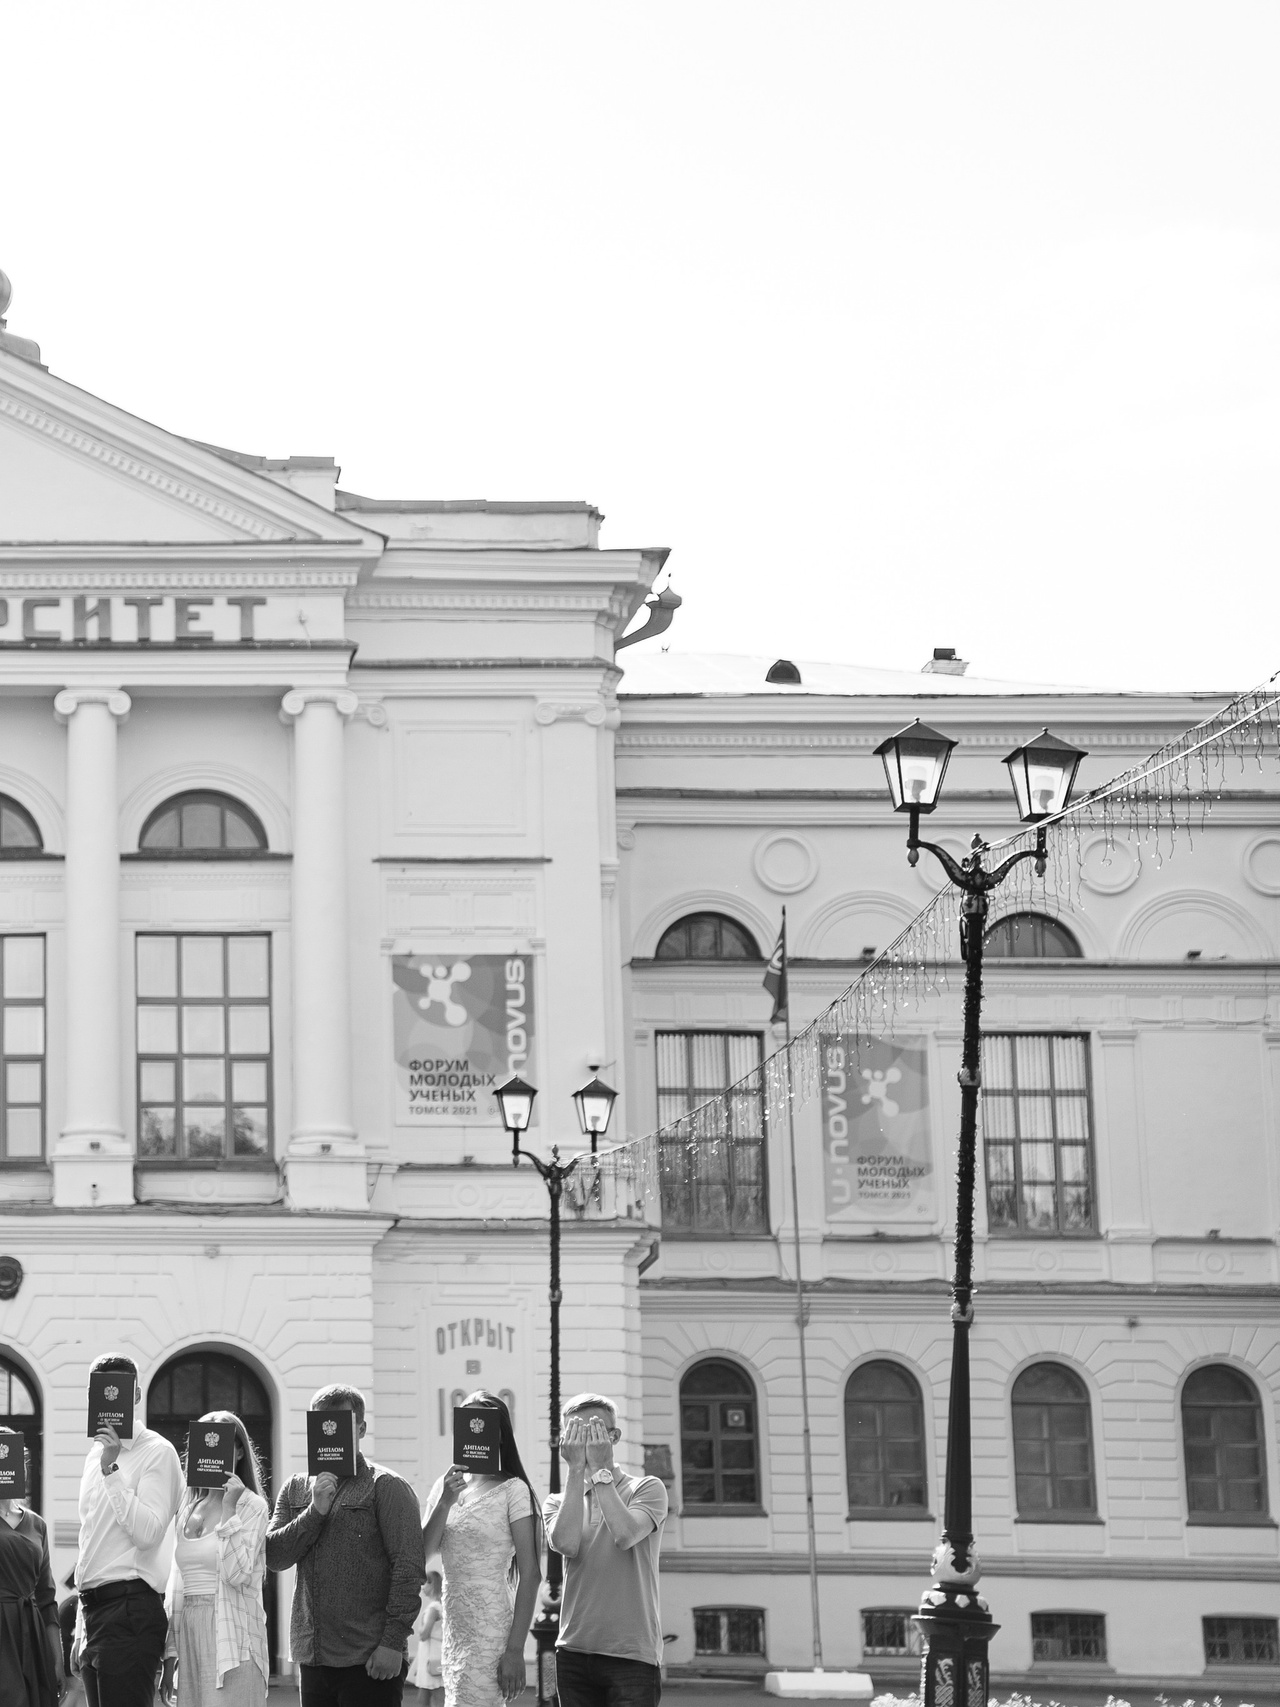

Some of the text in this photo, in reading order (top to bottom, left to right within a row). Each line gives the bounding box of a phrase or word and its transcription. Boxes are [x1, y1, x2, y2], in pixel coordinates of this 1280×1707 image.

[409, 1059, 469, 1072] ФОРУМ
[409, 1074, 497, 1088] МОЛОДЫХ
[409, 1090, 476, 1102] УЧЕНЫХ
[409, 1106, 477, 1115] ТОМСК 2021
[857, 1155, 903, 1166] ФОРУМ
[858, 1167, 925, 1178] МОЛОДЫХ
[858, 1179, 910, 1189] УЧЕНЫХ
[436, 1318, 515, 1355] ОТКРЫТ
[466, 1360, 481, 1375] В
